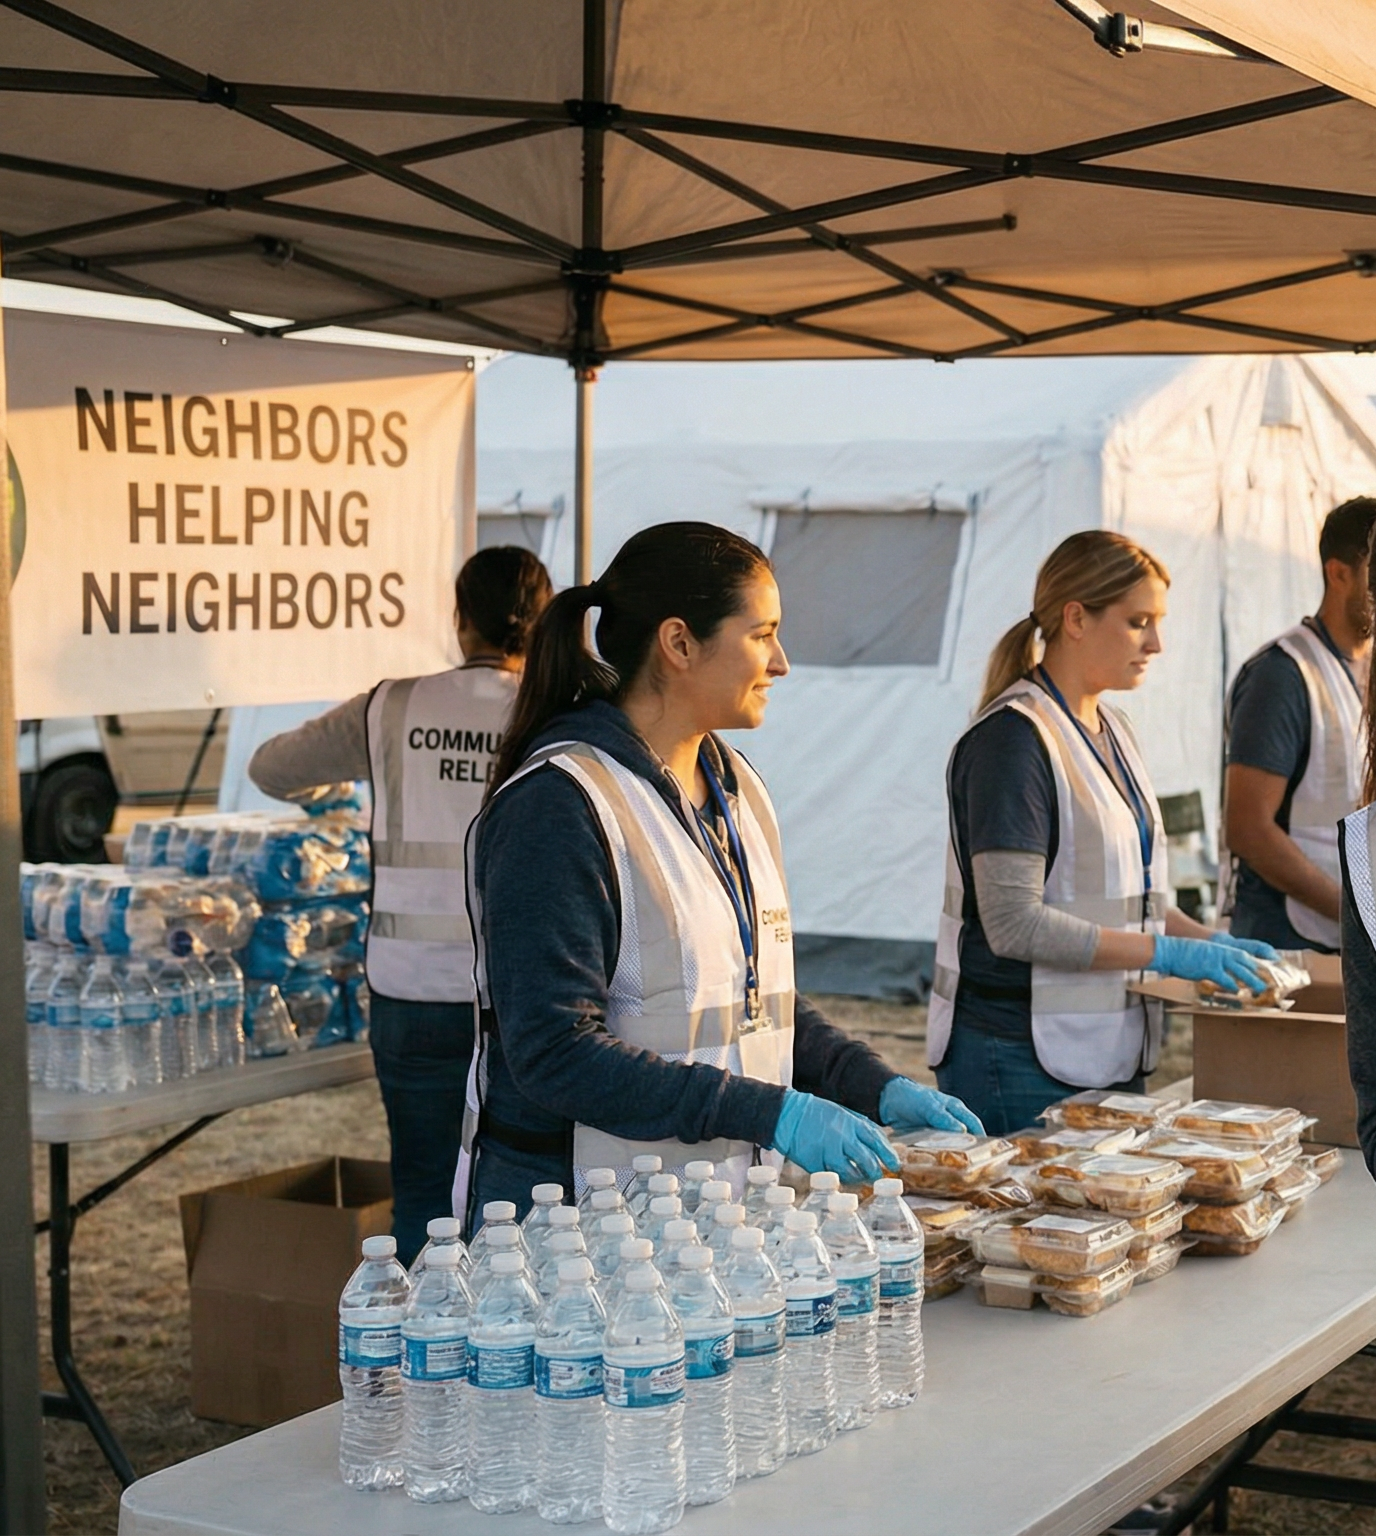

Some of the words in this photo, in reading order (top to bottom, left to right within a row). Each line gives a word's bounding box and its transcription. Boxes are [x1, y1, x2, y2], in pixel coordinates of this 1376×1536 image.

[75, 387, 408, 467] NEIGHBORS
[128, 482, 369, 547] HELPING
[82, 571, 406, 634] NEIGHBORS
[409, 727, 502, 754] COMMU
